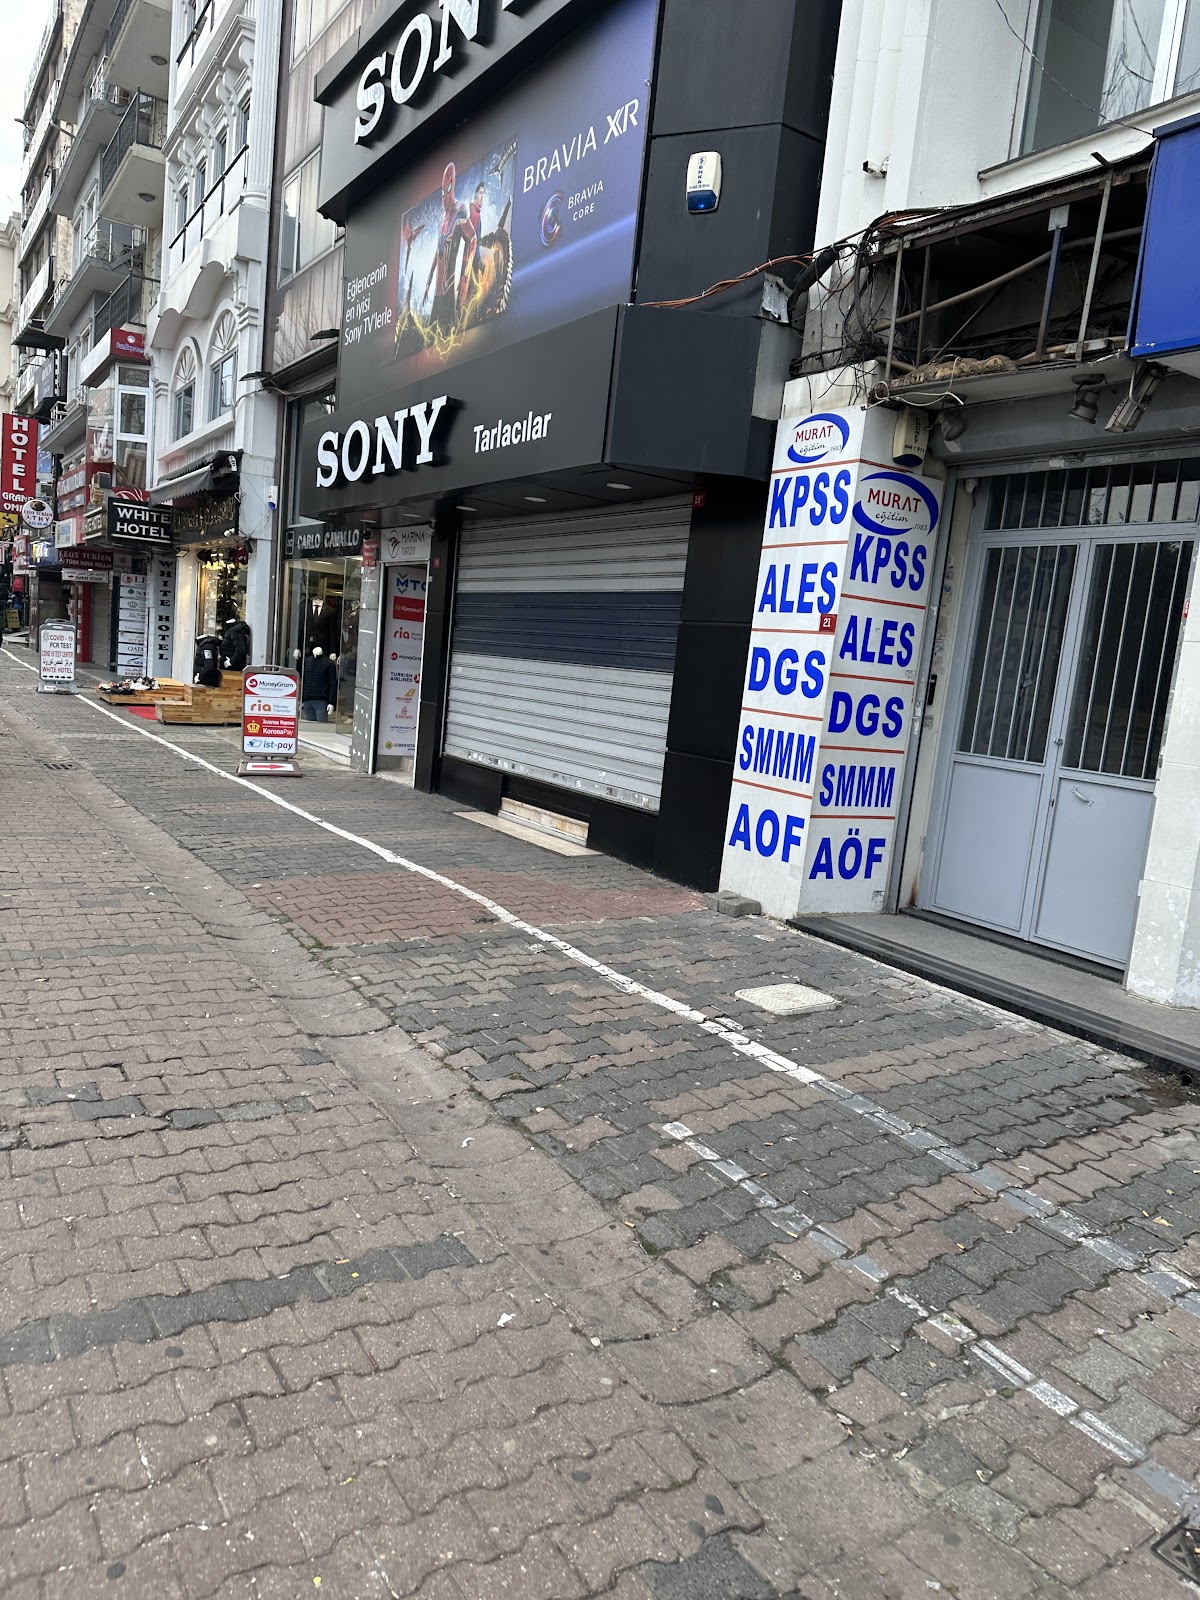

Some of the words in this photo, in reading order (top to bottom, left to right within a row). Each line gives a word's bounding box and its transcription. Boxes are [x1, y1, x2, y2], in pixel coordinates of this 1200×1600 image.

[354, 0, 515, 144] SON
[523, 126, 597, 193] BRAVIA
[604, 98, 639, 144] XR
[568, 179, 604, 209] BRAVIA
[573, 202, 595, 221] CORE
[346, 262, 387, 301] Eğlencenin
[344, 324, 363, 345] Sony
[364, 306, 392, 335] TV'lerle
[345, 306, 355, 322] en
[356, 293, 371, 320] iyisi
[316, 394, 448, 488] SONY
[473, 410, 552, 453] Tarlacılar
[795, 425, 833, 443] MURAT
[800, 442, 825, 456] eğitim
[11, 416, 29, 492] HOTEL
[117, 506, 171, 524] WHITE
[768, 469, 851, 529] KPSS
[867, 487, 922, 513] MURAT
[875, 511, 909, 524] eğitim
[116, 521, 171, 539] HOTEL
[297, 533, 321, 550] CARLO
[324, 528, 360, 548] CAVALLO
[914, 523, 928, 531] 1983
[59, 550, 79, 559] LEON
[849, 532, 927, 591] KPSS
[158, 560, 174, 607] WHITE
[758, 561, 838, 614] ALES
[157, 614, 171, 661] HOTEL
[394, 627, 410, 639] ria
[823, 617, 831, 628] 21
[839, 614, 915, 667] ALES
[50, 641, 60, 649] PCR
[748, 647, 826, 698] DGS
[251, 700, 271, 712] ria
[827, 691, 905, 738] DGS
[262, 727, 294, 736] KoronaPay
[263, 740, 294, 751] ist-pay
[739, 724, 816, 784] SMMM
[819, 764, 896, 808] SMMM
[728, 803, 805, 863] AOF
[808, 827, 886, 880] AÖF
